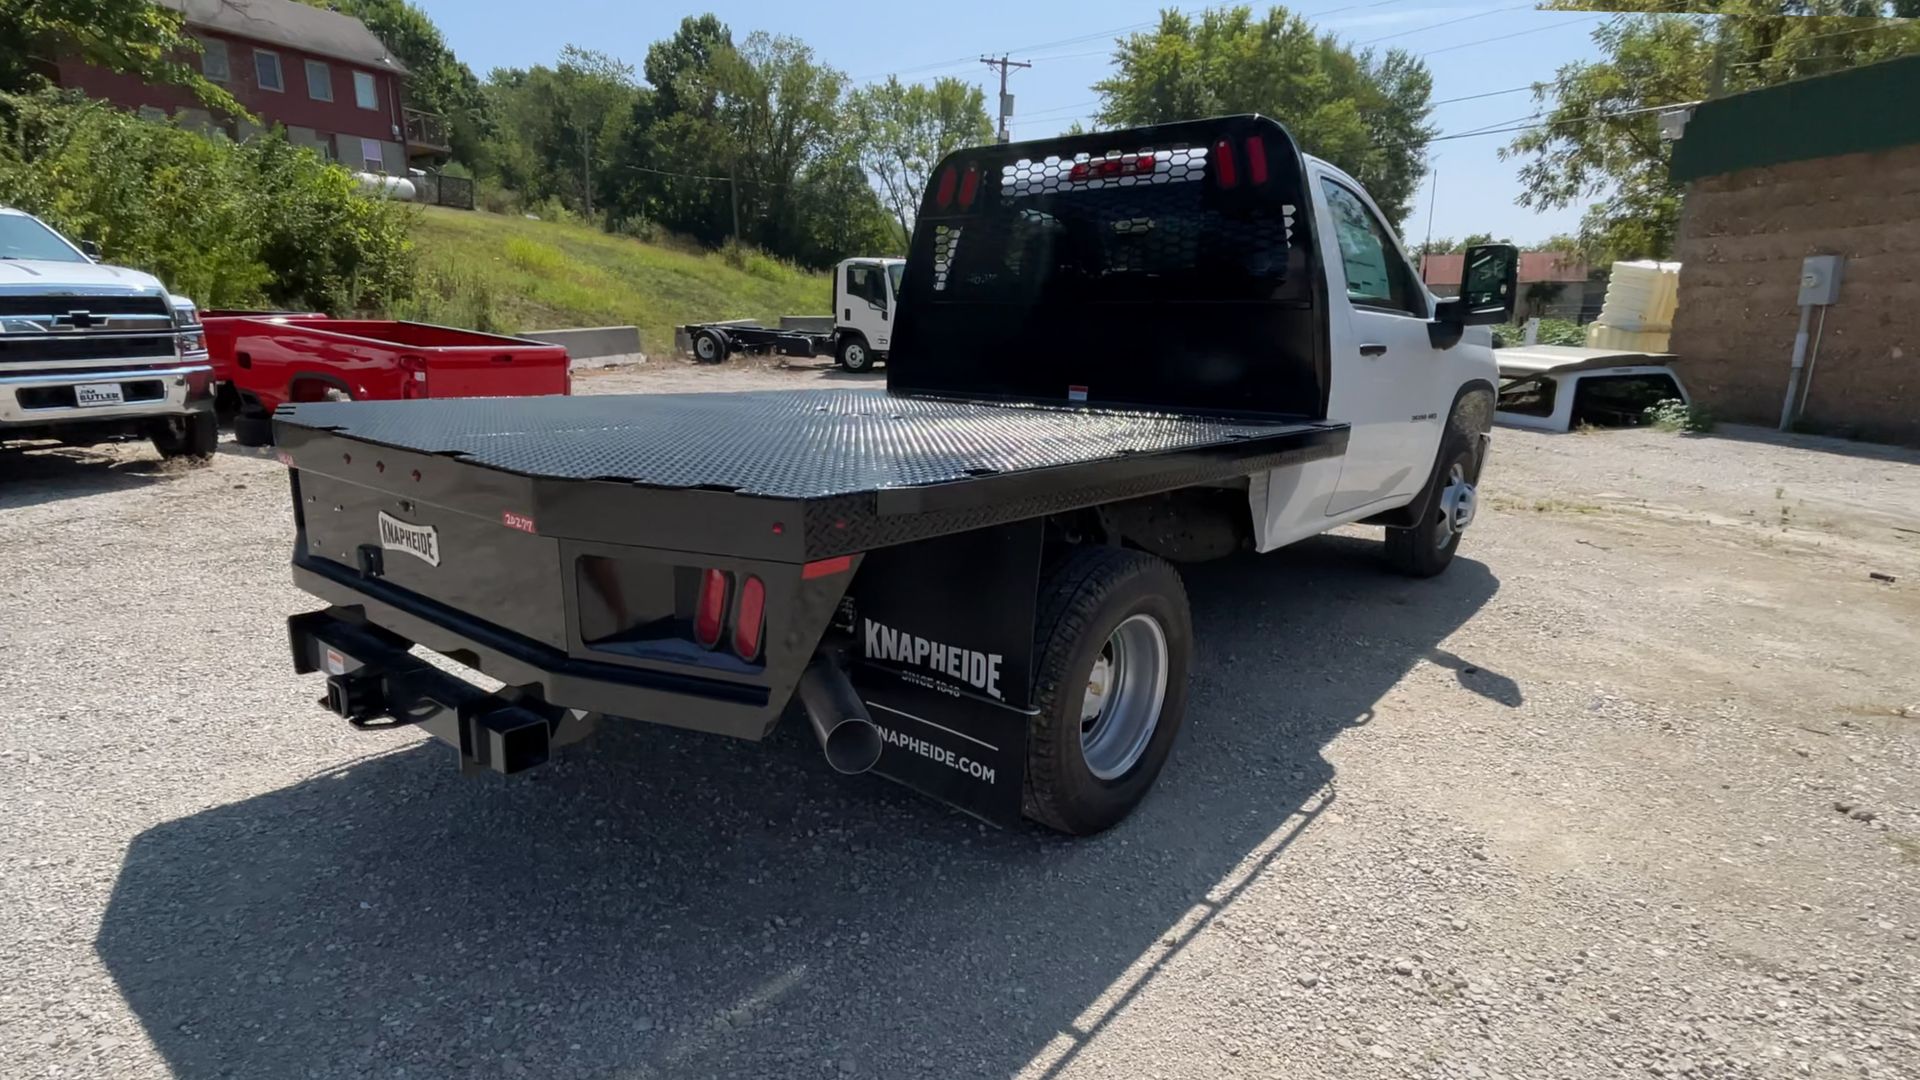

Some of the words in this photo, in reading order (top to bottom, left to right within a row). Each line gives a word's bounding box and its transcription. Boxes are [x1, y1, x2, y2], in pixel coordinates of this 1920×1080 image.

[79, 393, 119, 401] BUTLER
[380, 517, 435, 560] KNAPHEIDE
[864, 617, 1003, 700] KNAPHEIDE
[874, 723, 996, 785] NAPHEIDE.COM
